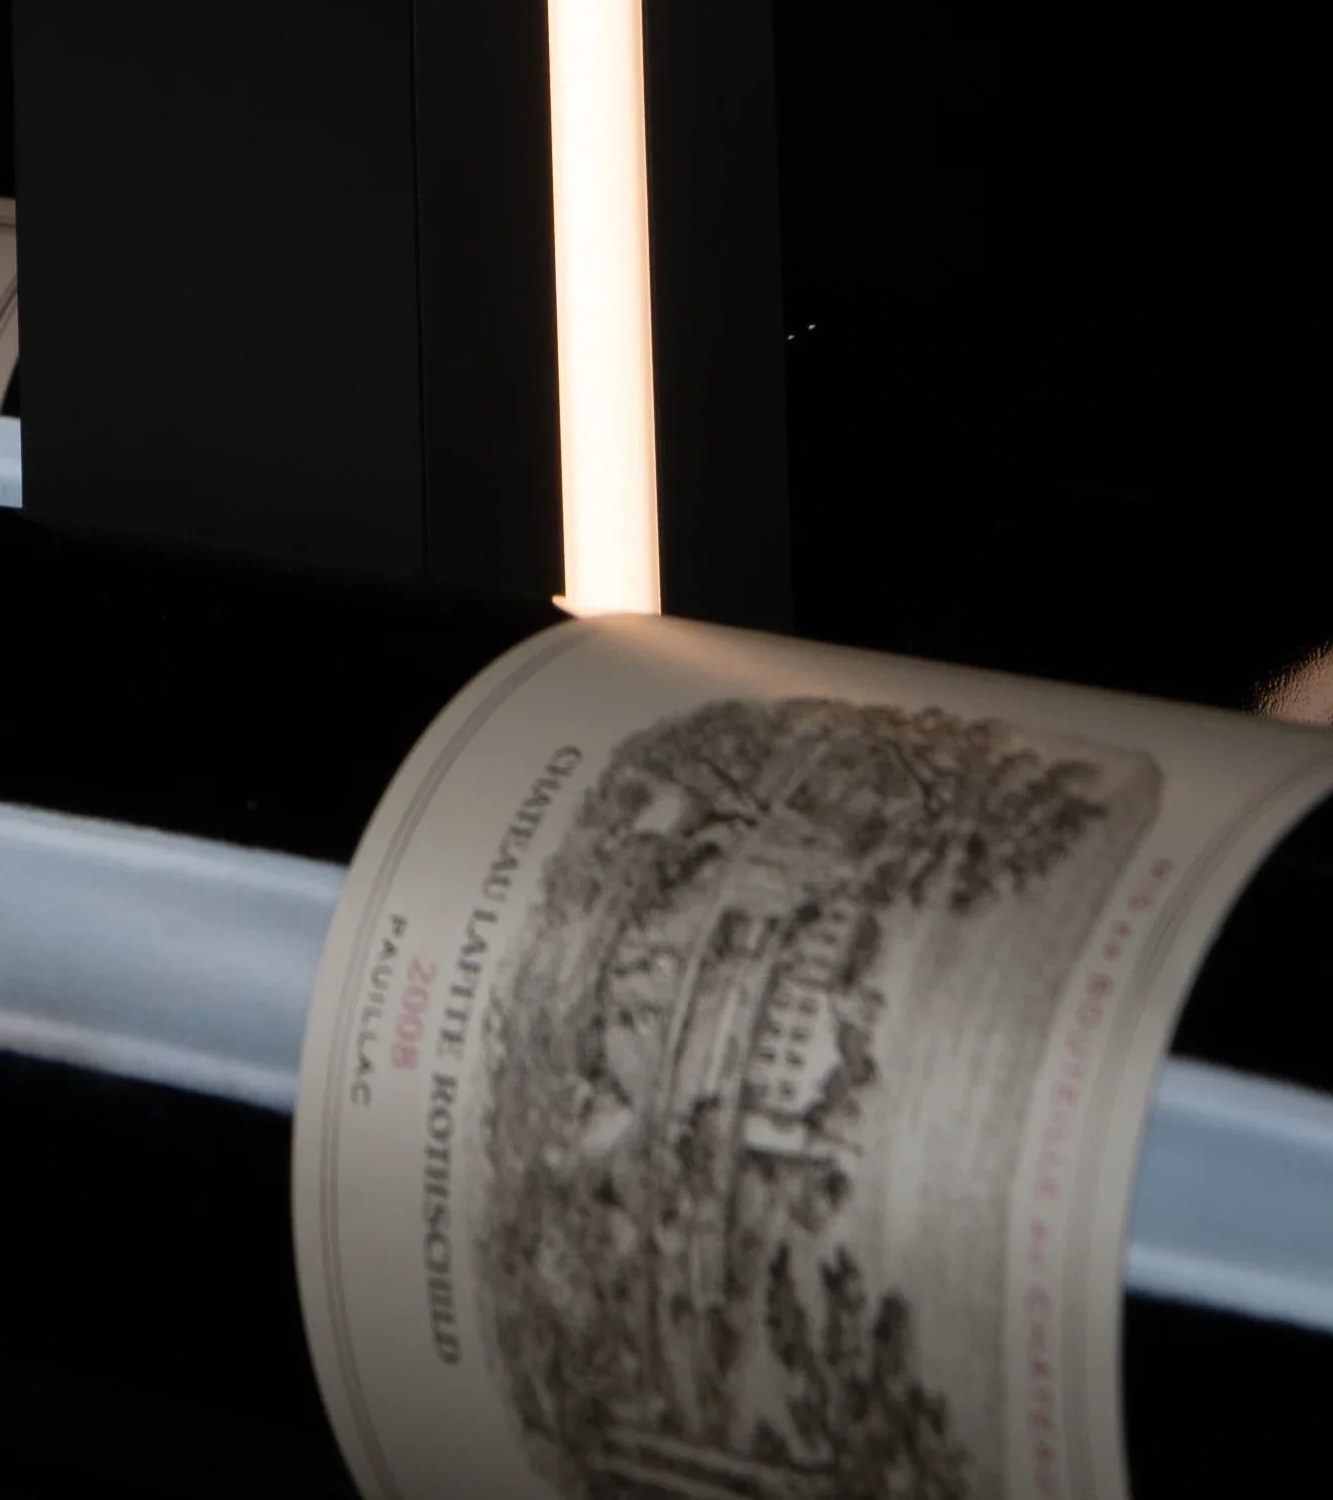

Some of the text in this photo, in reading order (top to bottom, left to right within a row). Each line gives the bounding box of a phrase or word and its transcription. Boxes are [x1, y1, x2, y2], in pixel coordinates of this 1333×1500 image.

[350, 912, 409, 1109] PAUILLAC
[389, 957, 438, 1073] 2008
[423, 743, 584, 1368] CHATEAU LAFITE ROTHSCHILD
